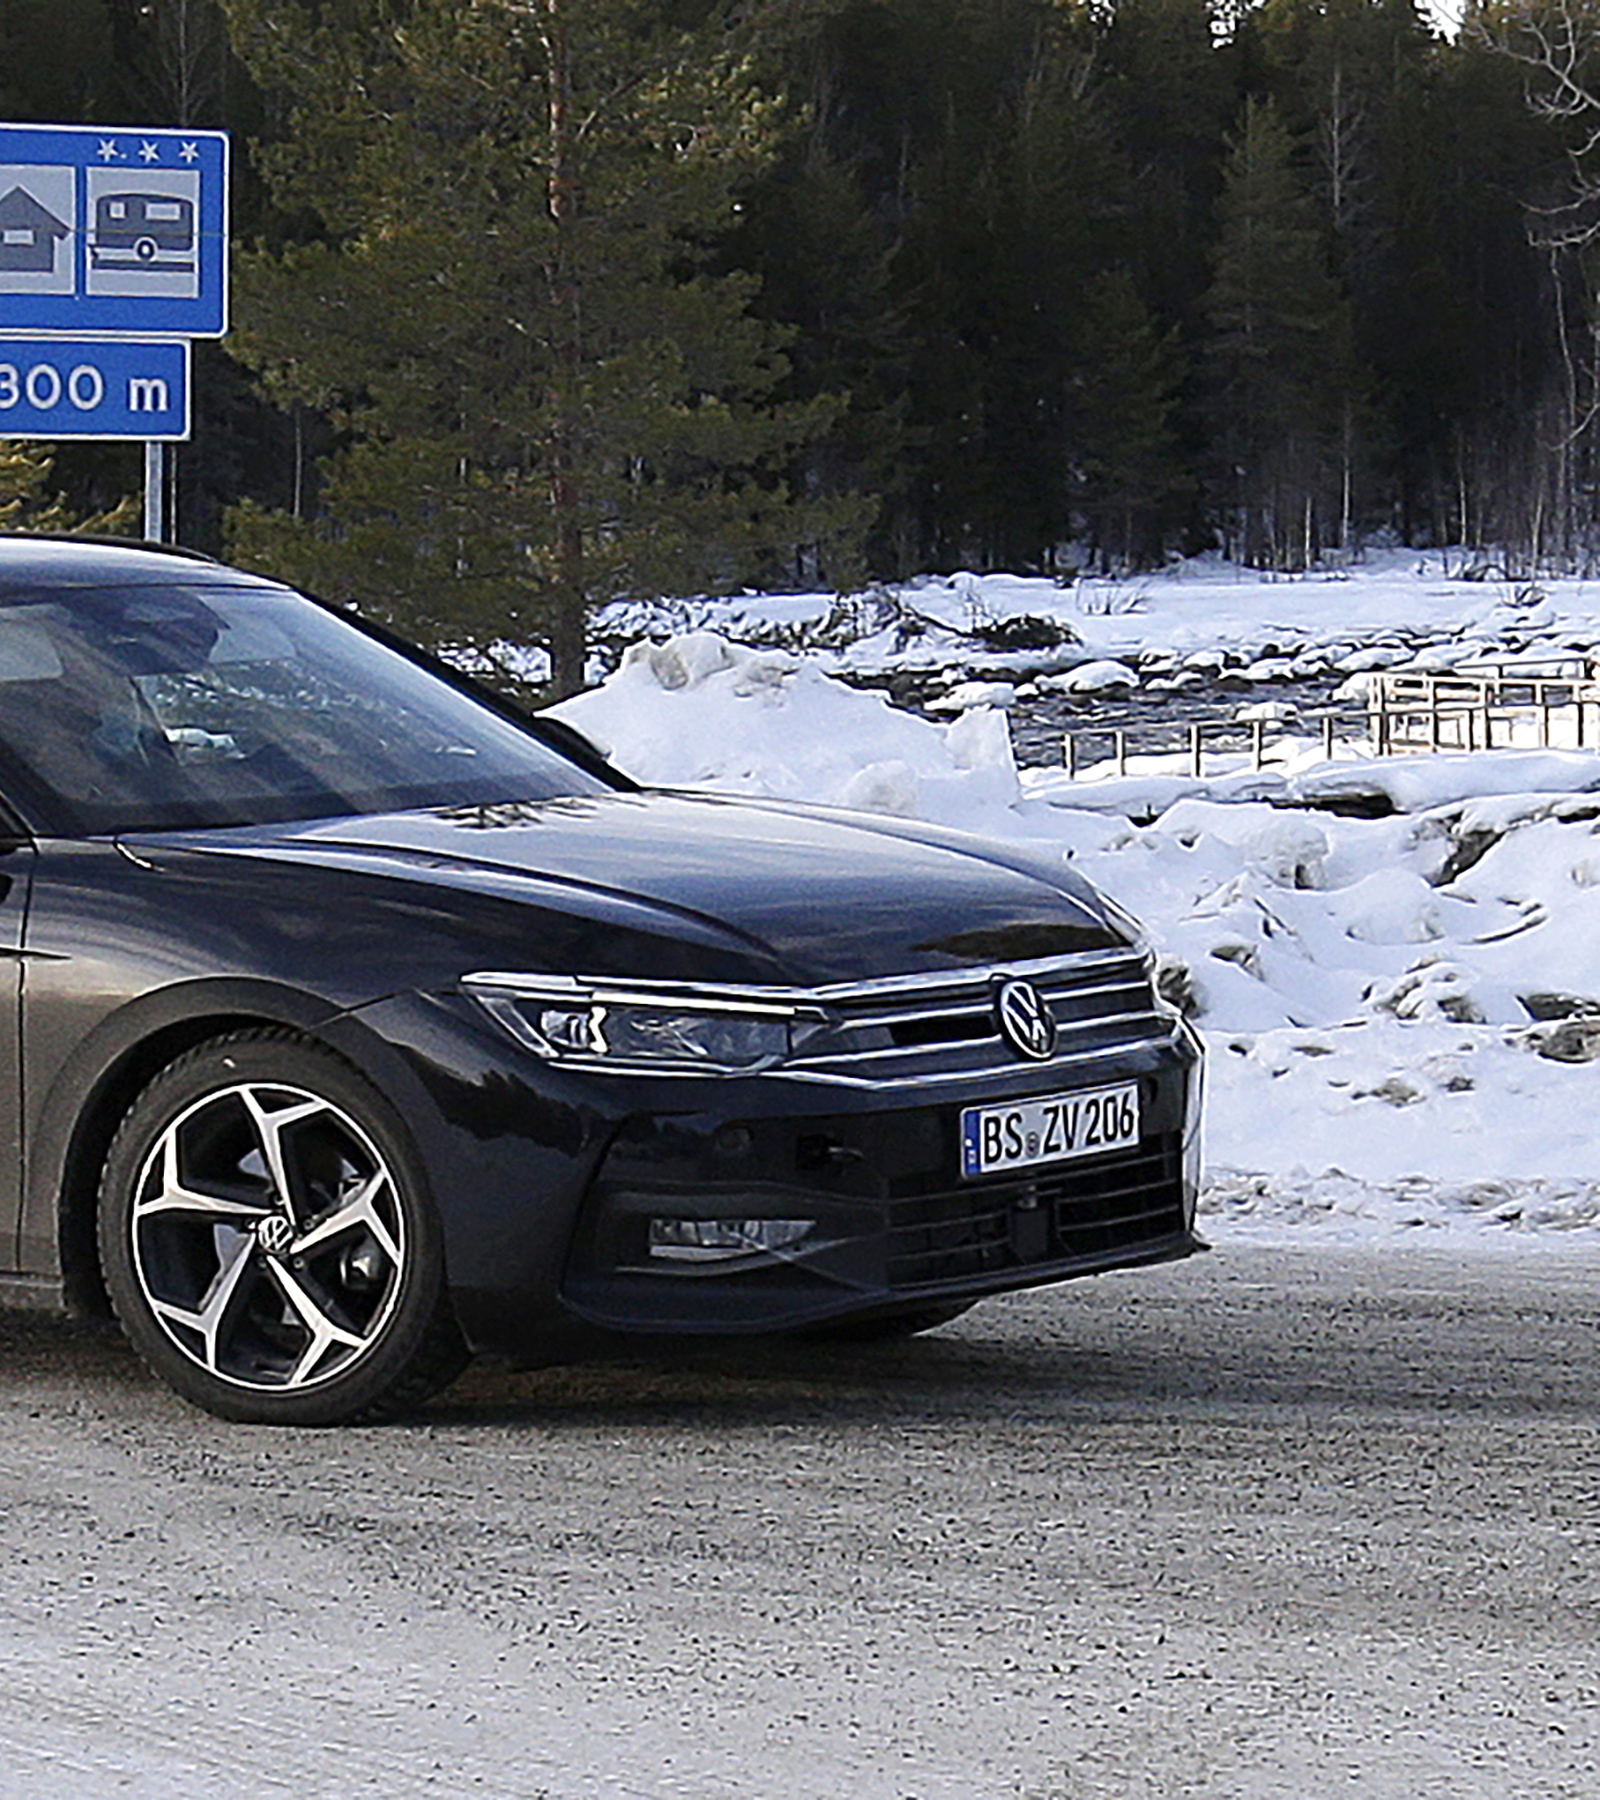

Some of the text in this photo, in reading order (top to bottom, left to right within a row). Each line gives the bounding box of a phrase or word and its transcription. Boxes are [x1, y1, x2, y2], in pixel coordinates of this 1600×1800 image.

[129, 376, 168, 412] m
[984, 1093, 1134, 1164] BS ZV 206
